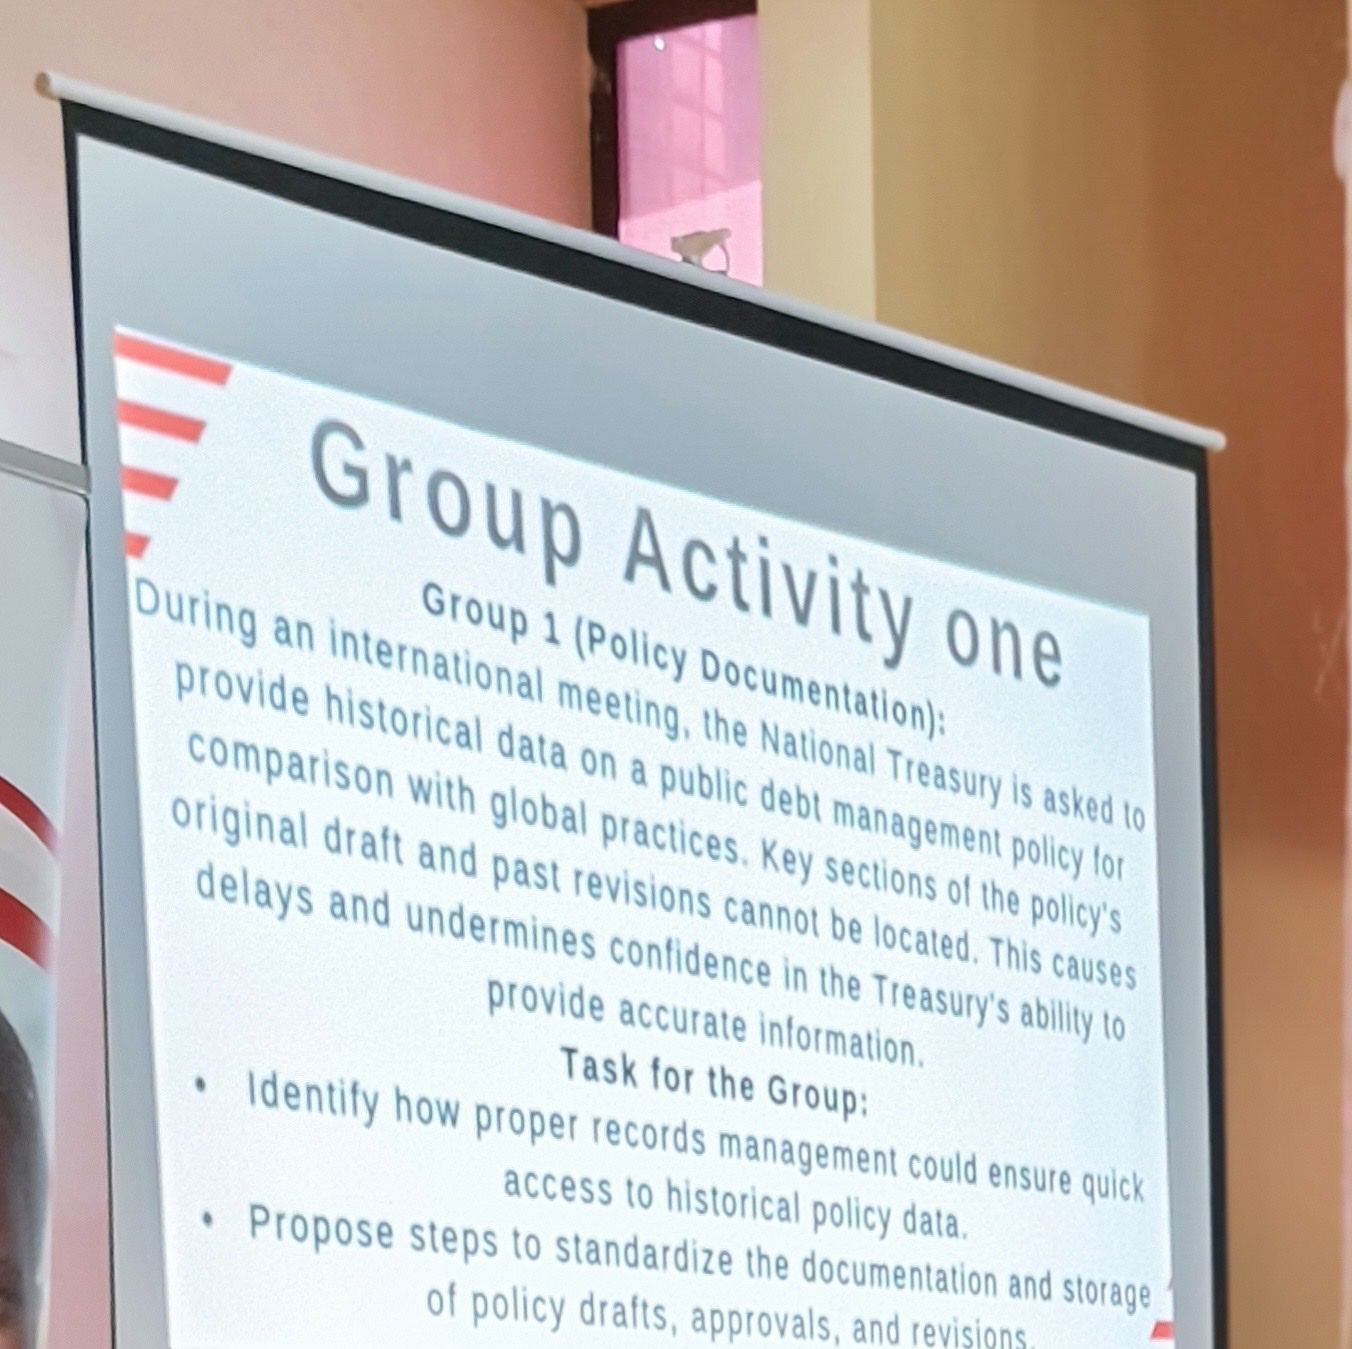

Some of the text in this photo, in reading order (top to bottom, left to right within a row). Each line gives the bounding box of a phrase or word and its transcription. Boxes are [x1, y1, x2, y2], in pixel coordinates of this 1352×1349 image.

[311, 418, 1061, 688] Group Activity one
[136, 578, 1145, 832] During an international meeting, the National Treasury is asked to
[422, 582, 945, 741] Group 1 (Policy Documentation):
[176, 661, 1124, 881] provide historical data on a public debt management policy for
[189, 732, 1121, 938] comparison with global practices. Key sections of the policy's
[172, 798, 1136, 990] original draft and past revisions cannot be located. This causes
[197, 862, 1125, 1044] delays and undermines confidence in the Treasury's ability to
[488, 980, 923, 1067] provide accurate information.
[560, 1045, 867, 1123] Task for the Group:
[249, 1070, 1144, 1205] Identify how proper records management could ensure quick
[505, 1169, 967, 1240] access to historical policy data.
[250, 1204, 1150, 1316] Propose steps to standardize the documentation and storage
[427, 1281, 455, 1316] of
[473, 1285, 565, 1333] policy
[580, 1292, 676, 1336] drafts,
[692, 1307, 839, 1346] approvals,
[853, 1314, 899, 1345] and
